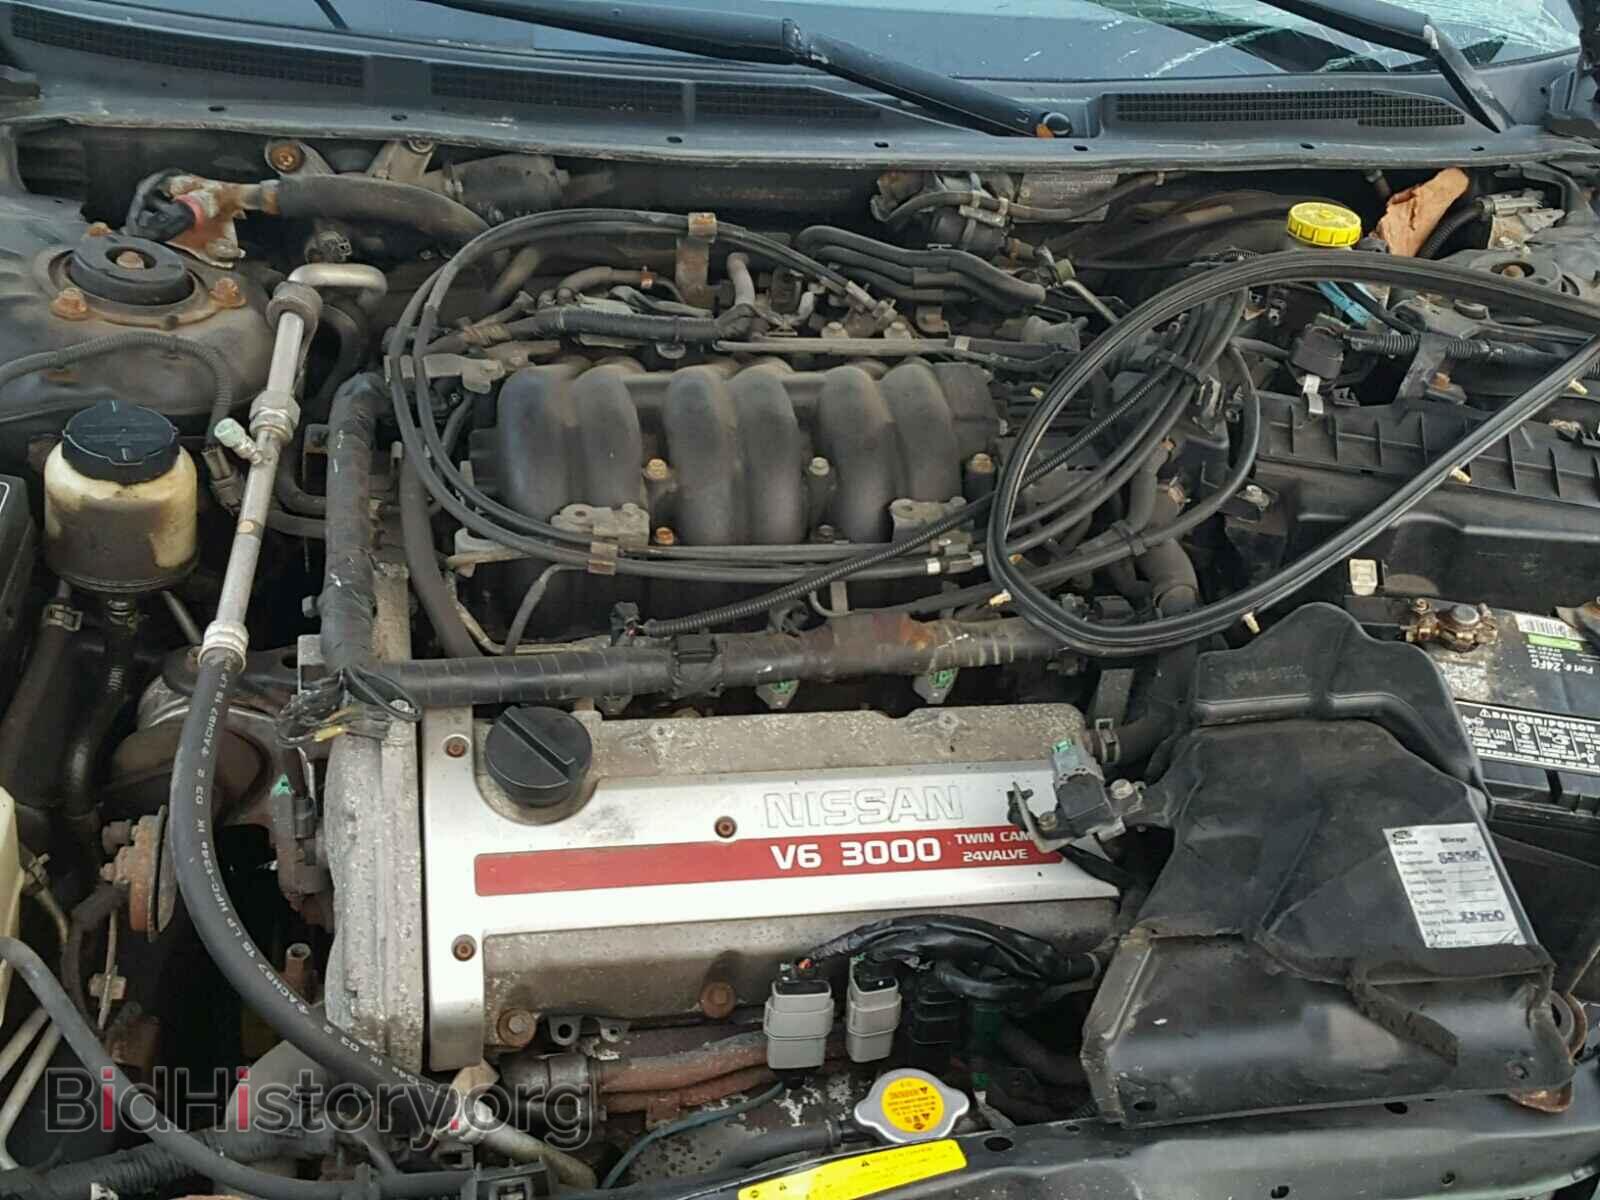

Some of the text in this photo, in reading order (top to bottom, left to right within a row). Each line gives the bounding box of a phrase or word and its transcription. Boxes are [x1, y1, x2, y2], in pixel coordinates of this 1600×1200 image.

[1531, 659, 1561, 672] 24FC
[763, 785, 965, 828] NISSAN
[954, 831, 1035, 845] TWIN CAM
[769, 837, 942, 871] V6 3000
[962, 848, 1029, 863] 24VALVE
